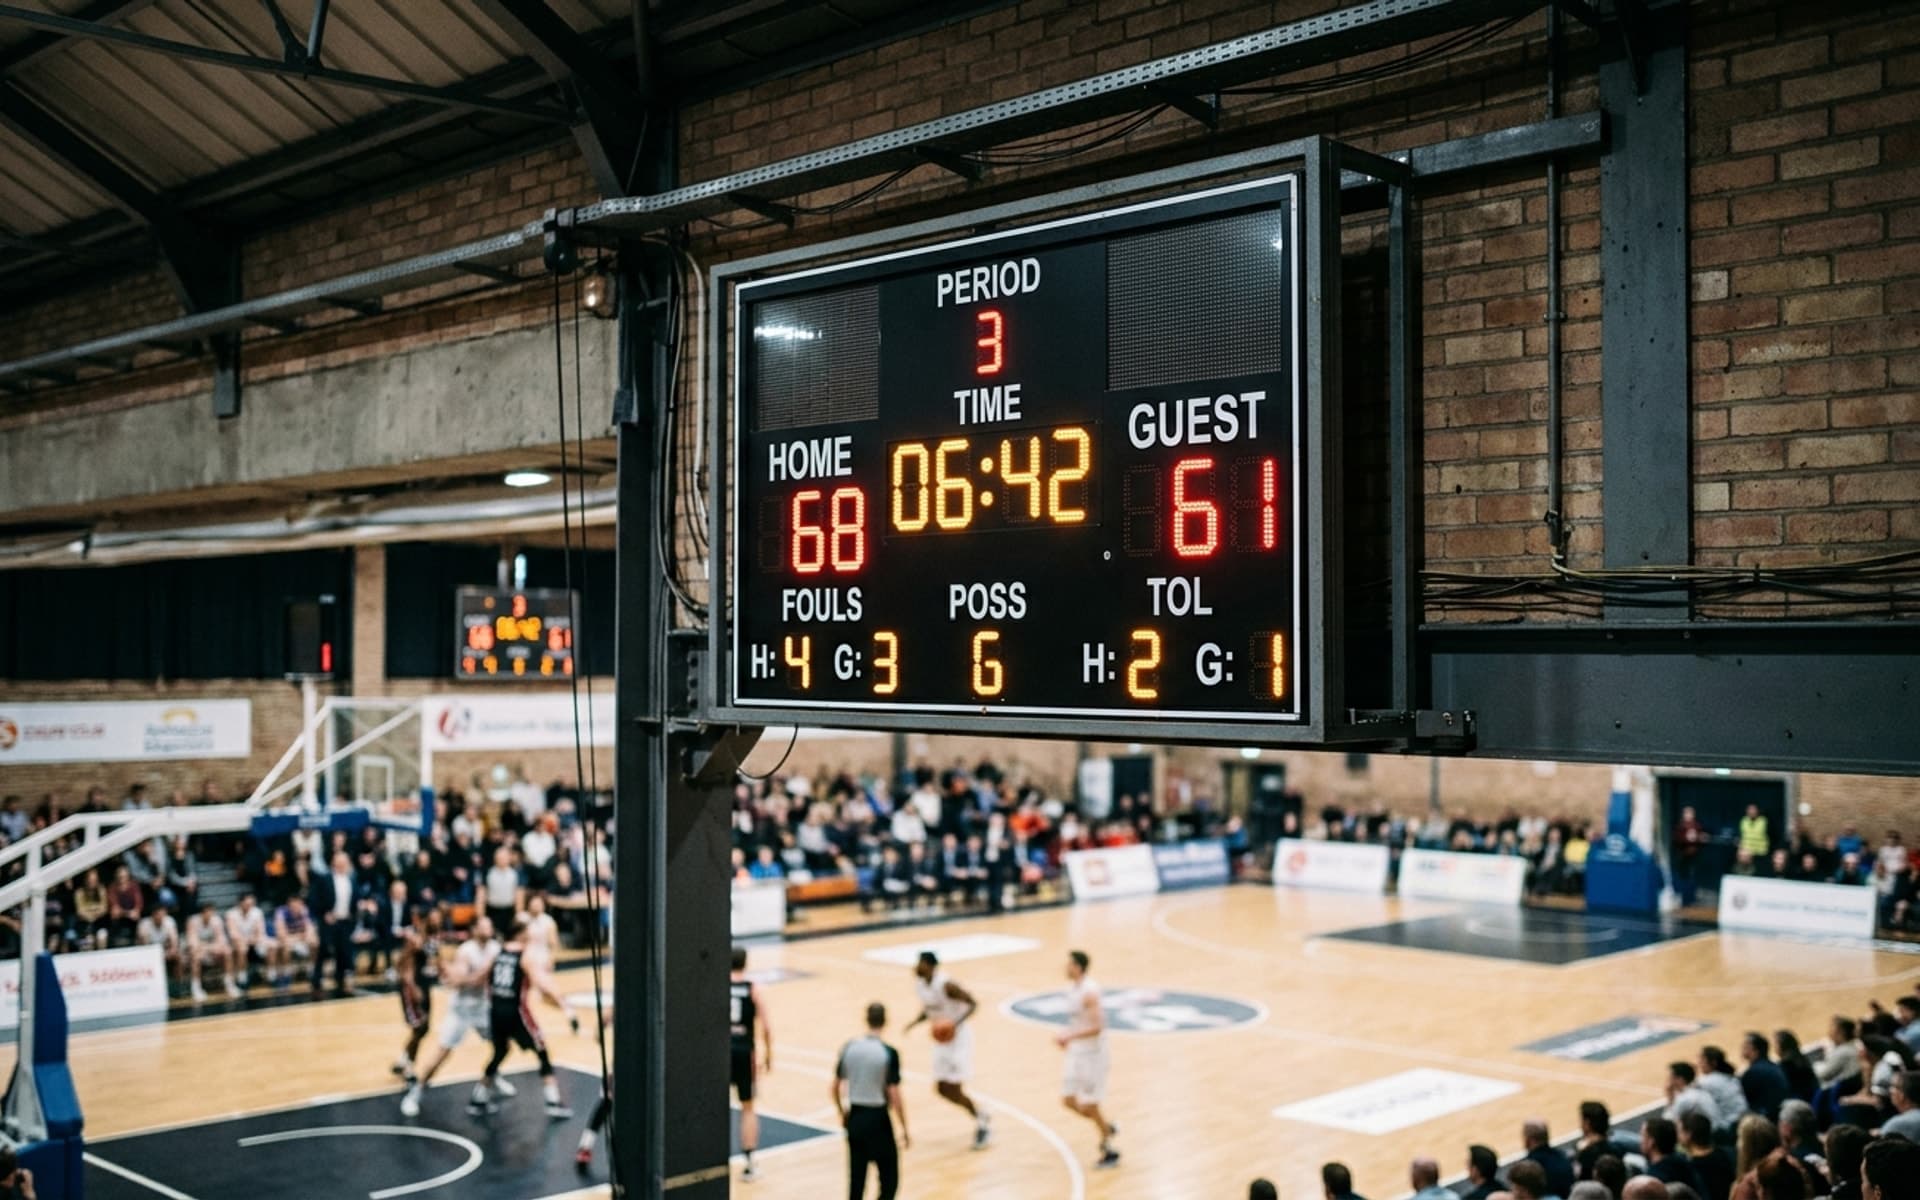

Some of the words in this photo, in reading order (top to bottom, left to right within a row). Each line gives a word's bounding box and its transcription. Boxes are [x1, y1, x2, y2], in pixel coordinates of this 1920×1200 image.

[937, 257, 1041, 308] PERIOD
[976, 310, 1004, 375] 3
[954, 384, 1021, 424] TIME
[1129, 391, 1266, 449] GUEST
[769, 436, 852, 481] HOME
[892, 427, 1091, 532] 06:42
[792, 487, 865, 574] 68
[1172, 457, 1278, 557] 61
[783, 587, 863, 622] FOULS
[949, 582, 1027, 620] POSS
[1147, 577, 1213, 616] TOL
[752, 644, 776, 679] H:
[784, 636, 810, 689] 4
[834, 644, 861, 680] G:
[873, 632, 898, 694] 3
[1083, 643, 1115, 682] H:
[1127, 629, 1161, 699] 2
[1196, 643, 1233, 686] G:
[1272, 632, 1284, 698] 1
